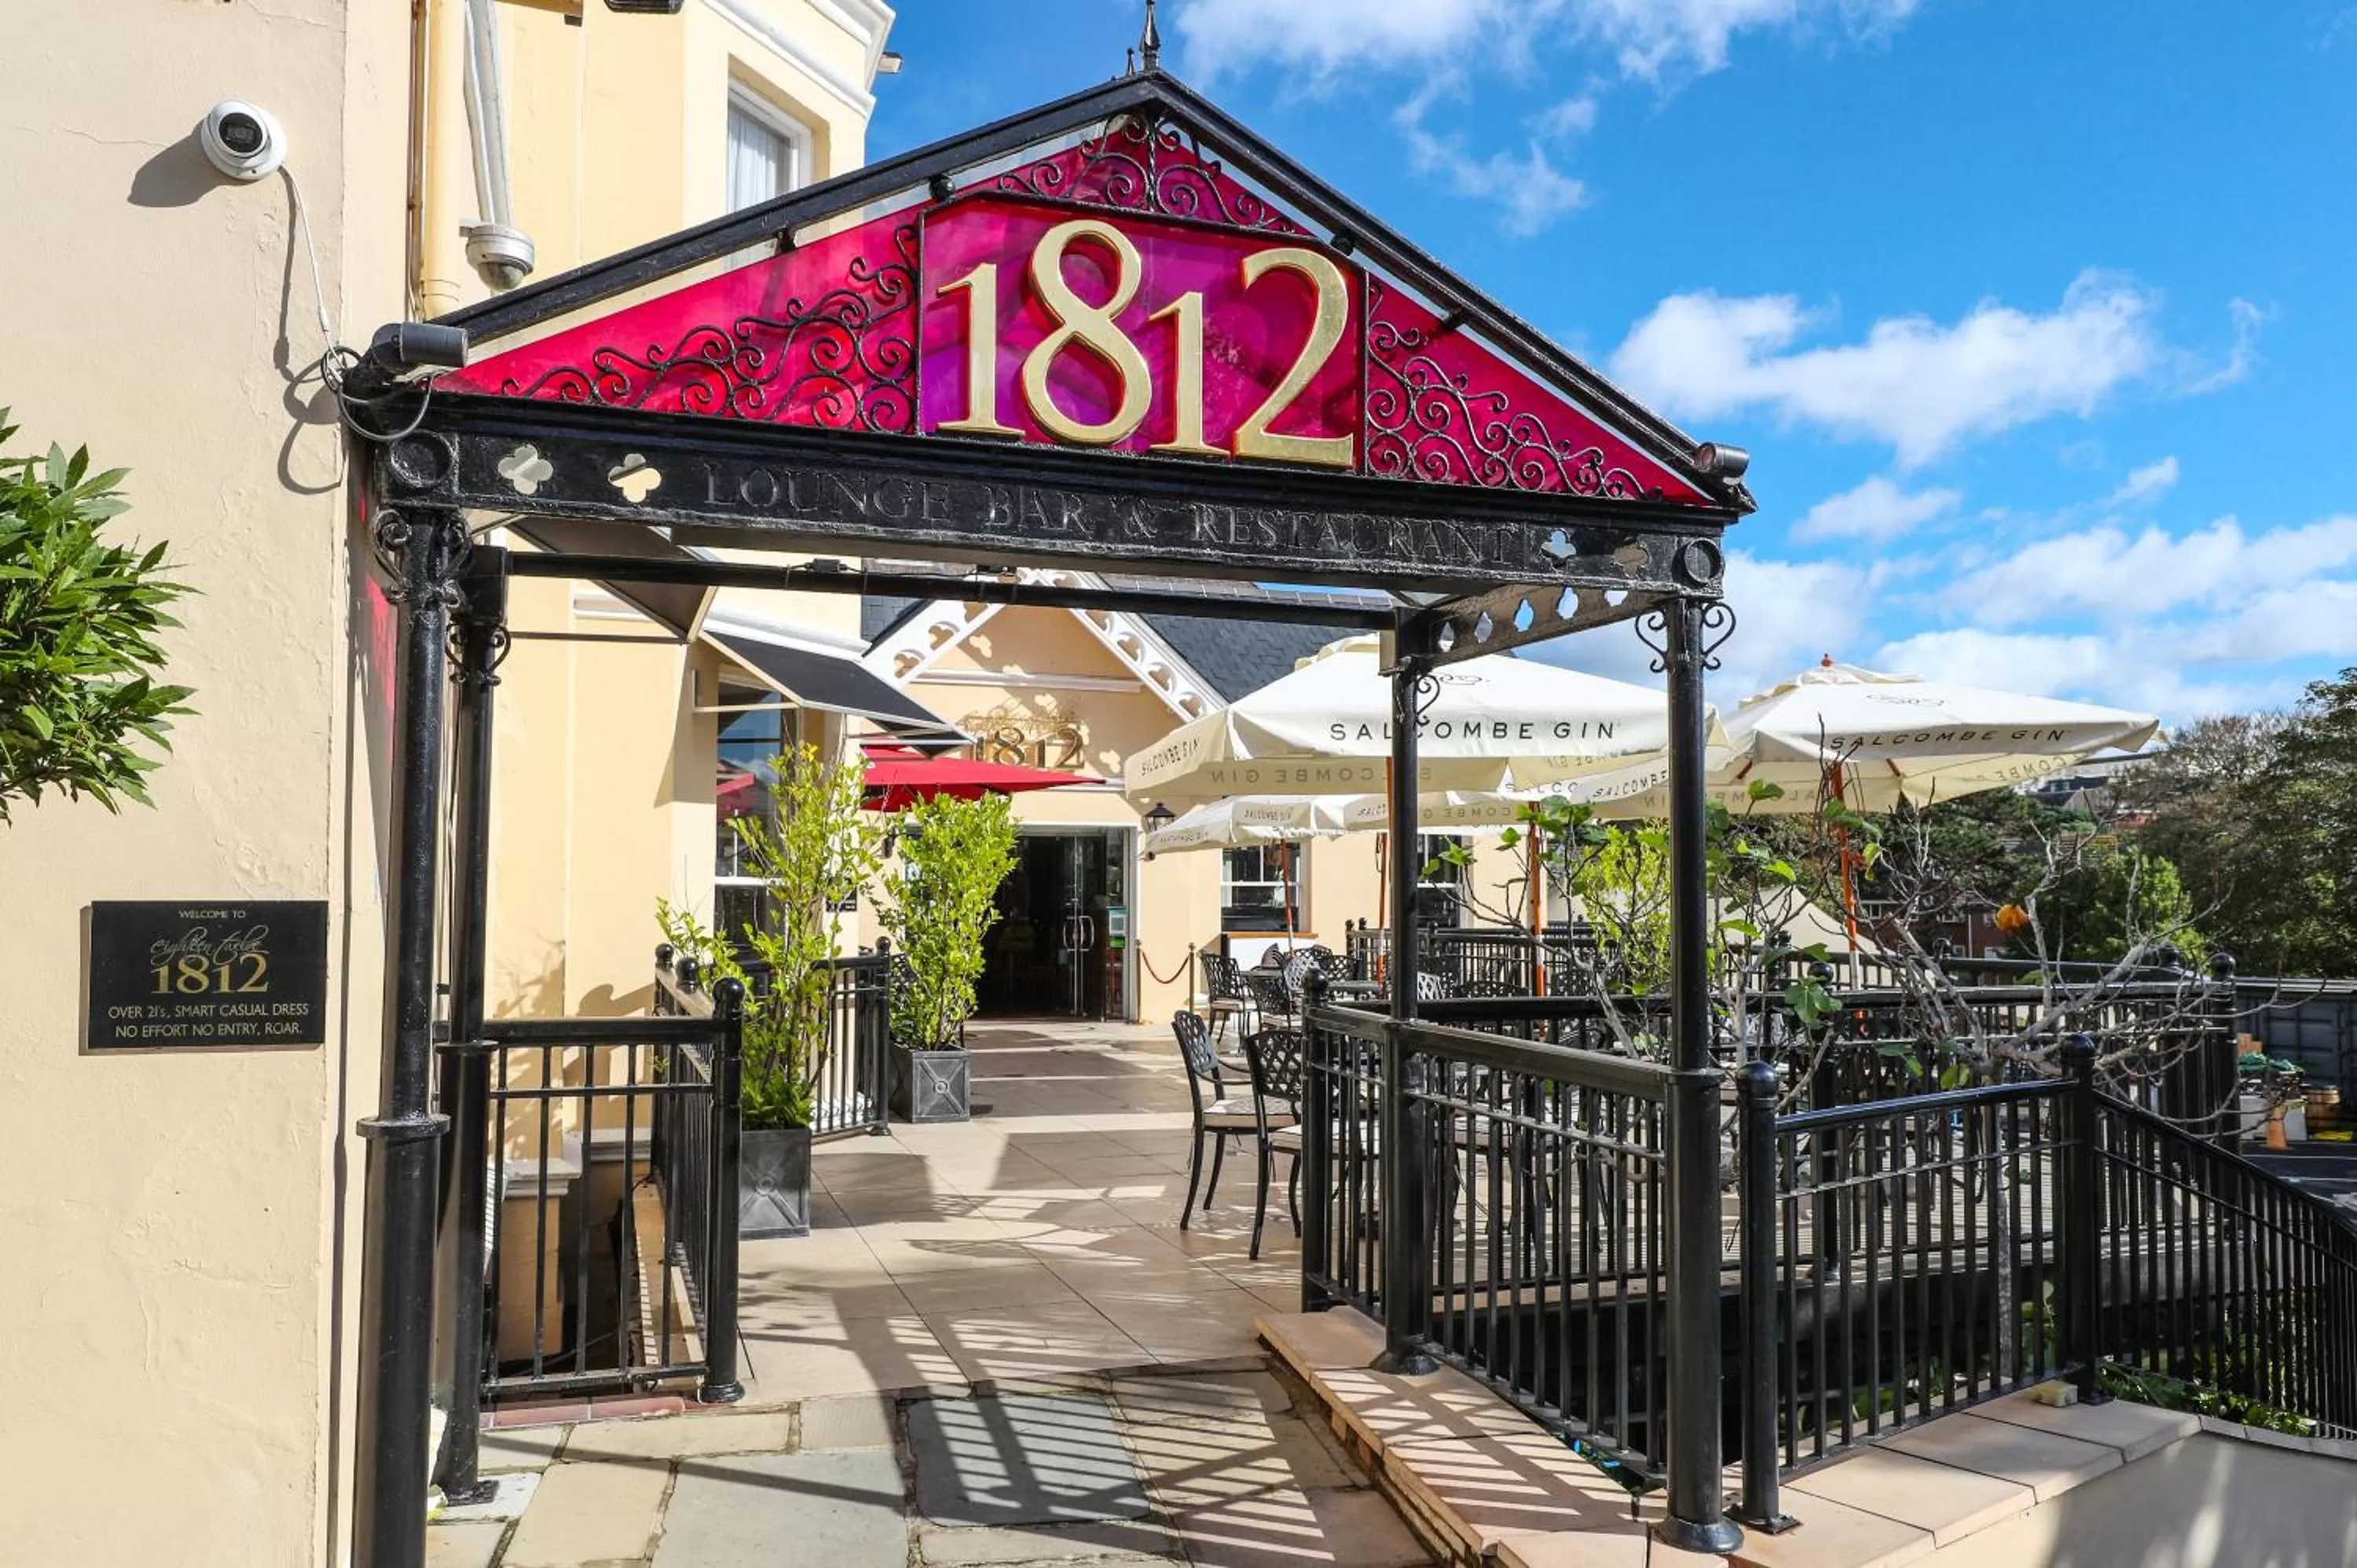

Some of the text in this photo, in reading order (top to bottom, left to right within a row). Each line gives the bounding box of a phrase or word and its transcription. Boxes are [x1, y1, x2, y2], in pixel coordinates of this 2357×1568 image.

[936, 219, 1354, 467] 1812
[703, 462, 1513, 566] LOUNGE BAR & RESTAURANT
[1330, 721, 1614, 741] SALOMBE GIN
[1830, 729, 2065, 750] SALCOMBE GIN
[973, 726, 1086, 768] 1812
[178, 910, 247, 918] WELCOME TO
[150, 954, 269, 995] 1812
[108, 1006, 143, 1020] OVER
[174, 1004, 216, 1018] SMART
[219, 1002, 268, 1017] CASUAL
[272, 1002, 310, 1016] DRESS
[115, 1024, 138, 1038] NO
[141, 1024, 189, 1038] EFFORT
[192, 1024, 214, 1037] NO
